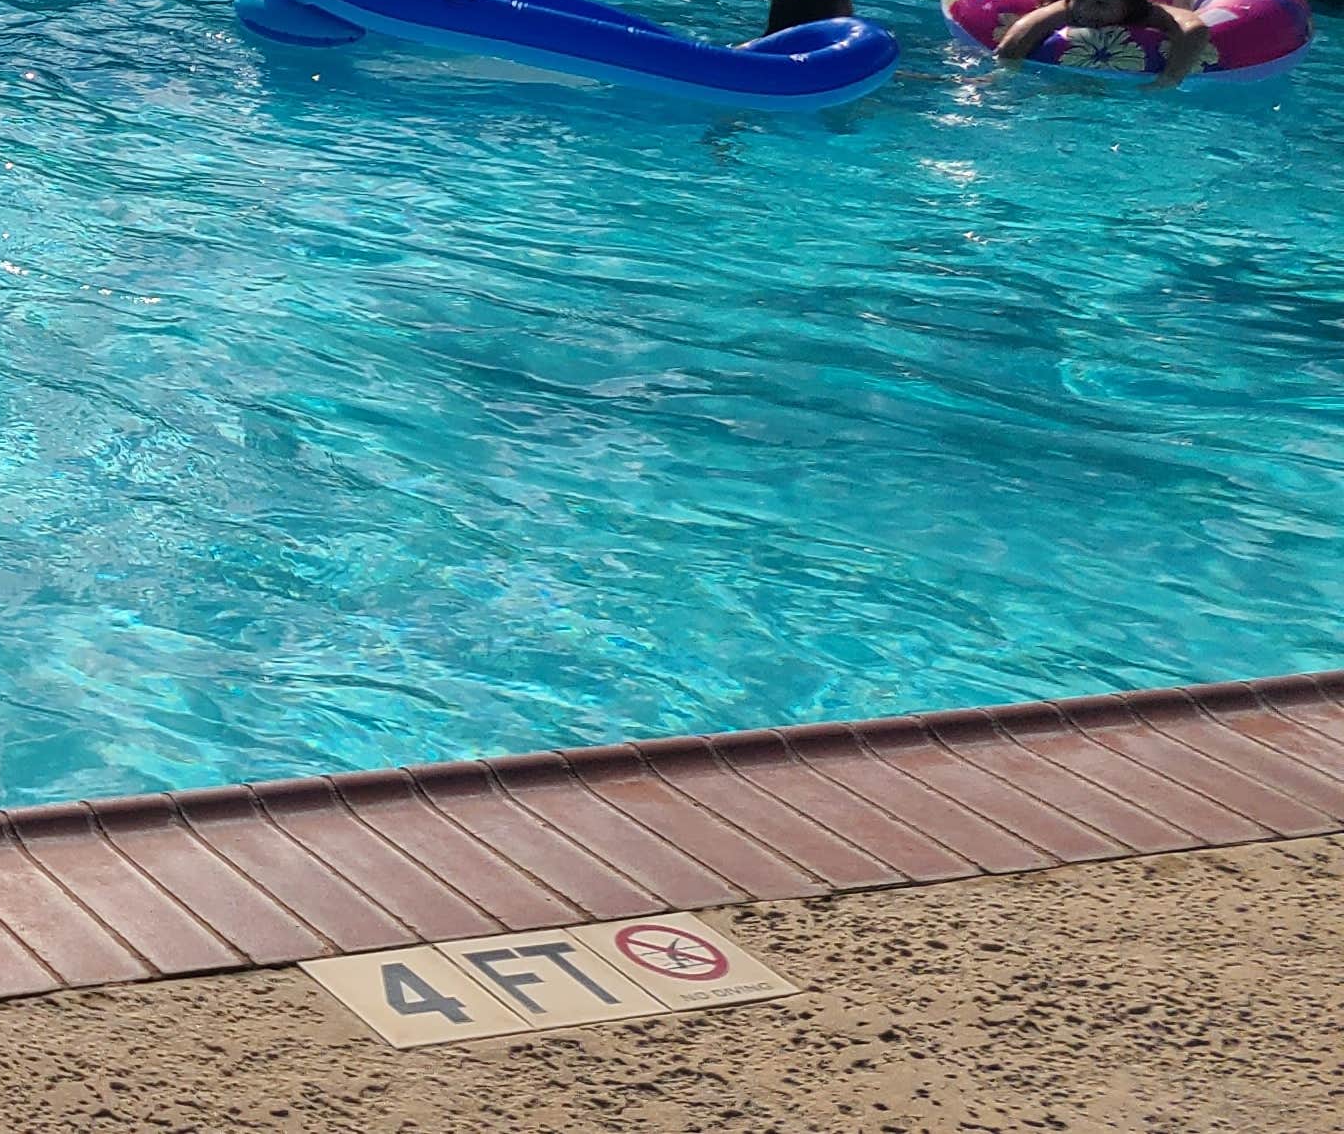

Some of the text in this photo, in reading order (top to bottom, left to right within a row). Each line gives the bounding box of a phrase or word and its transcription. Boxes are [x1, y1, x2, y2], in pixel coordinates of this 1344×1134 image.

[380, 941, 622, 1024] 4 FT
[680, 982, 775, 1003] NO DIVING
